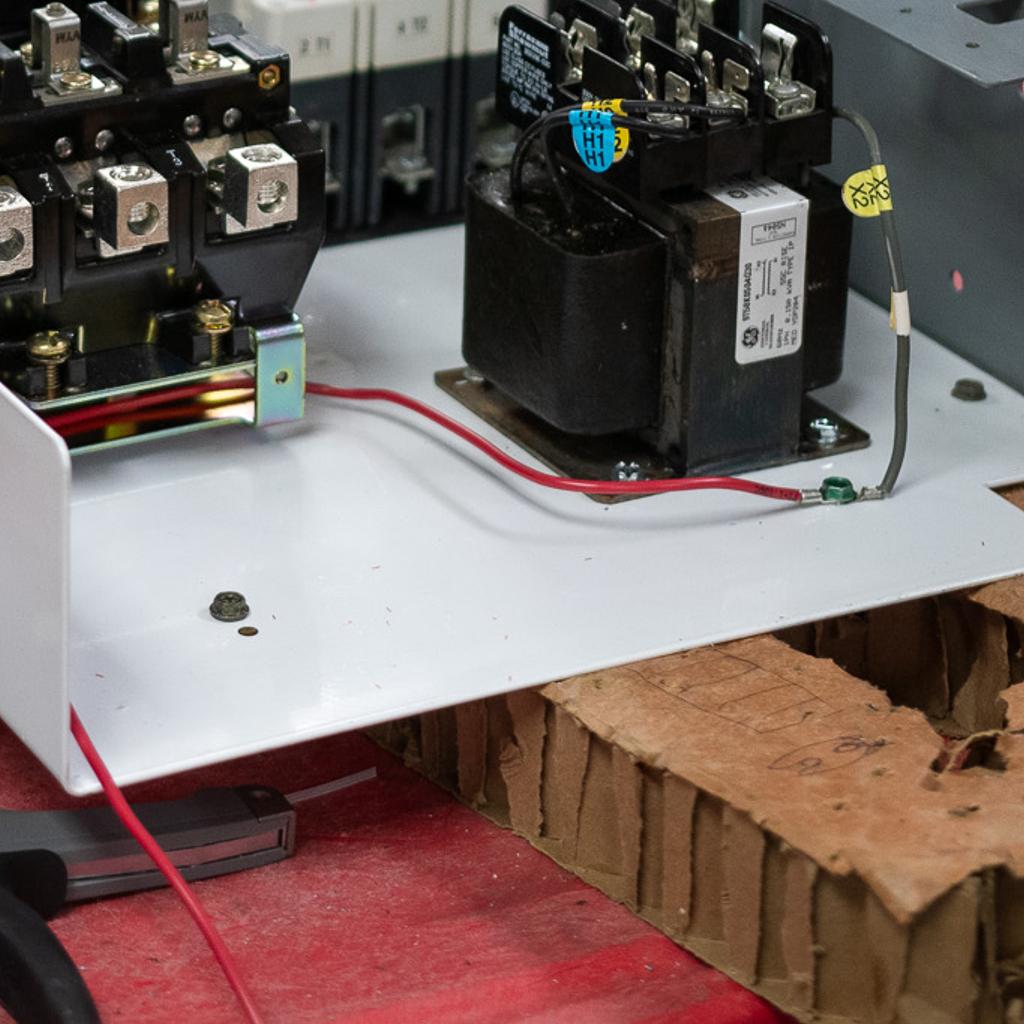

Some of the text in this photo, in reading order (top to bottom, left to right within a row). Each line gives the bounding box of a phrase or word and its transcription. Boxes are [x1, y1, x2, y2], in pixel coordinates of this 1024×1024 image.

[583, 132, 604, 149] H1
[585, 150, 605, 167] H1
[849, 183, 869, 209] X2
